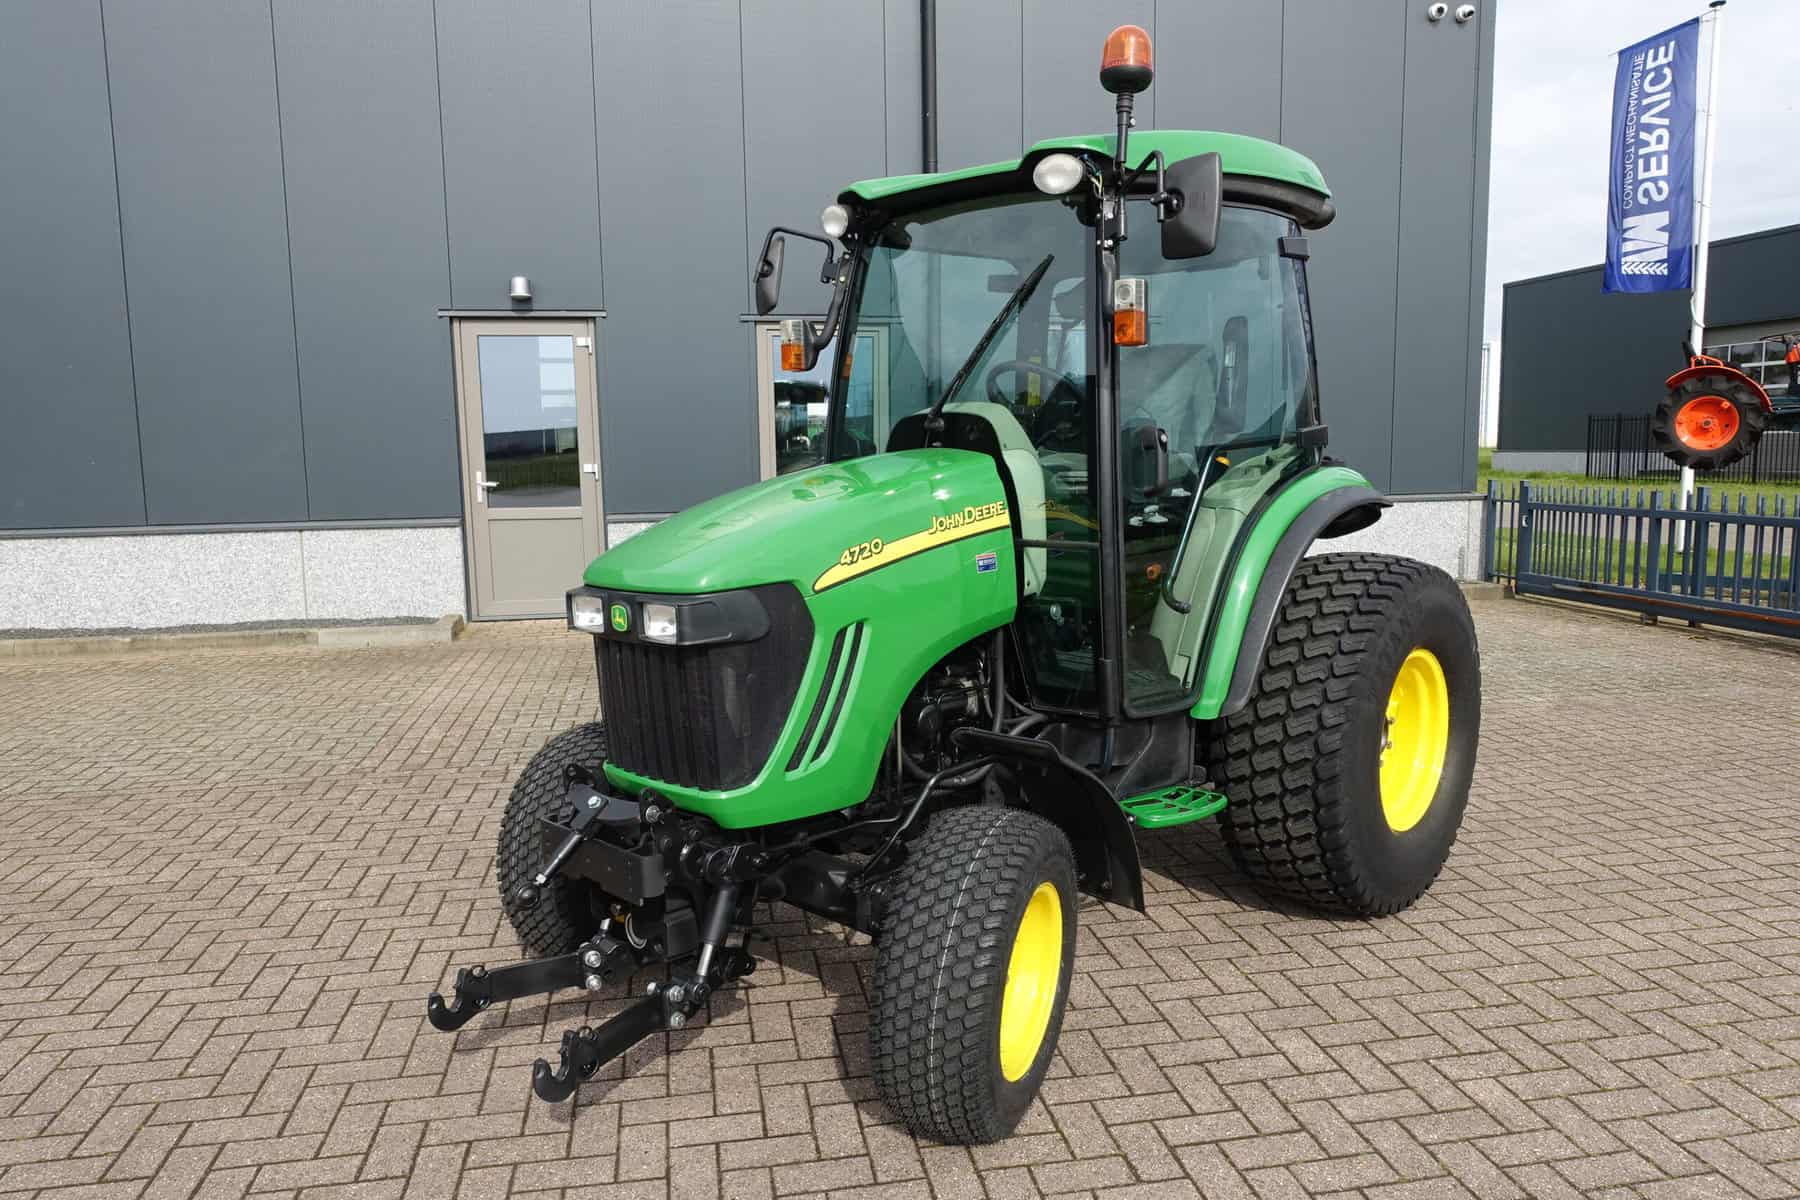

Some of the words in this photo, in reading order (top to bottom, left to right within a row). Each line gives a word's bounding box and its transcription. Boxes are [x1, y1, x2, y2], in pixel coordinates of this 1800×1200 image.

[928, 511, 964, 535] JOHN
[964, 501, 1005, 525] DEERE
[840, 538, 883, 566] 4720
